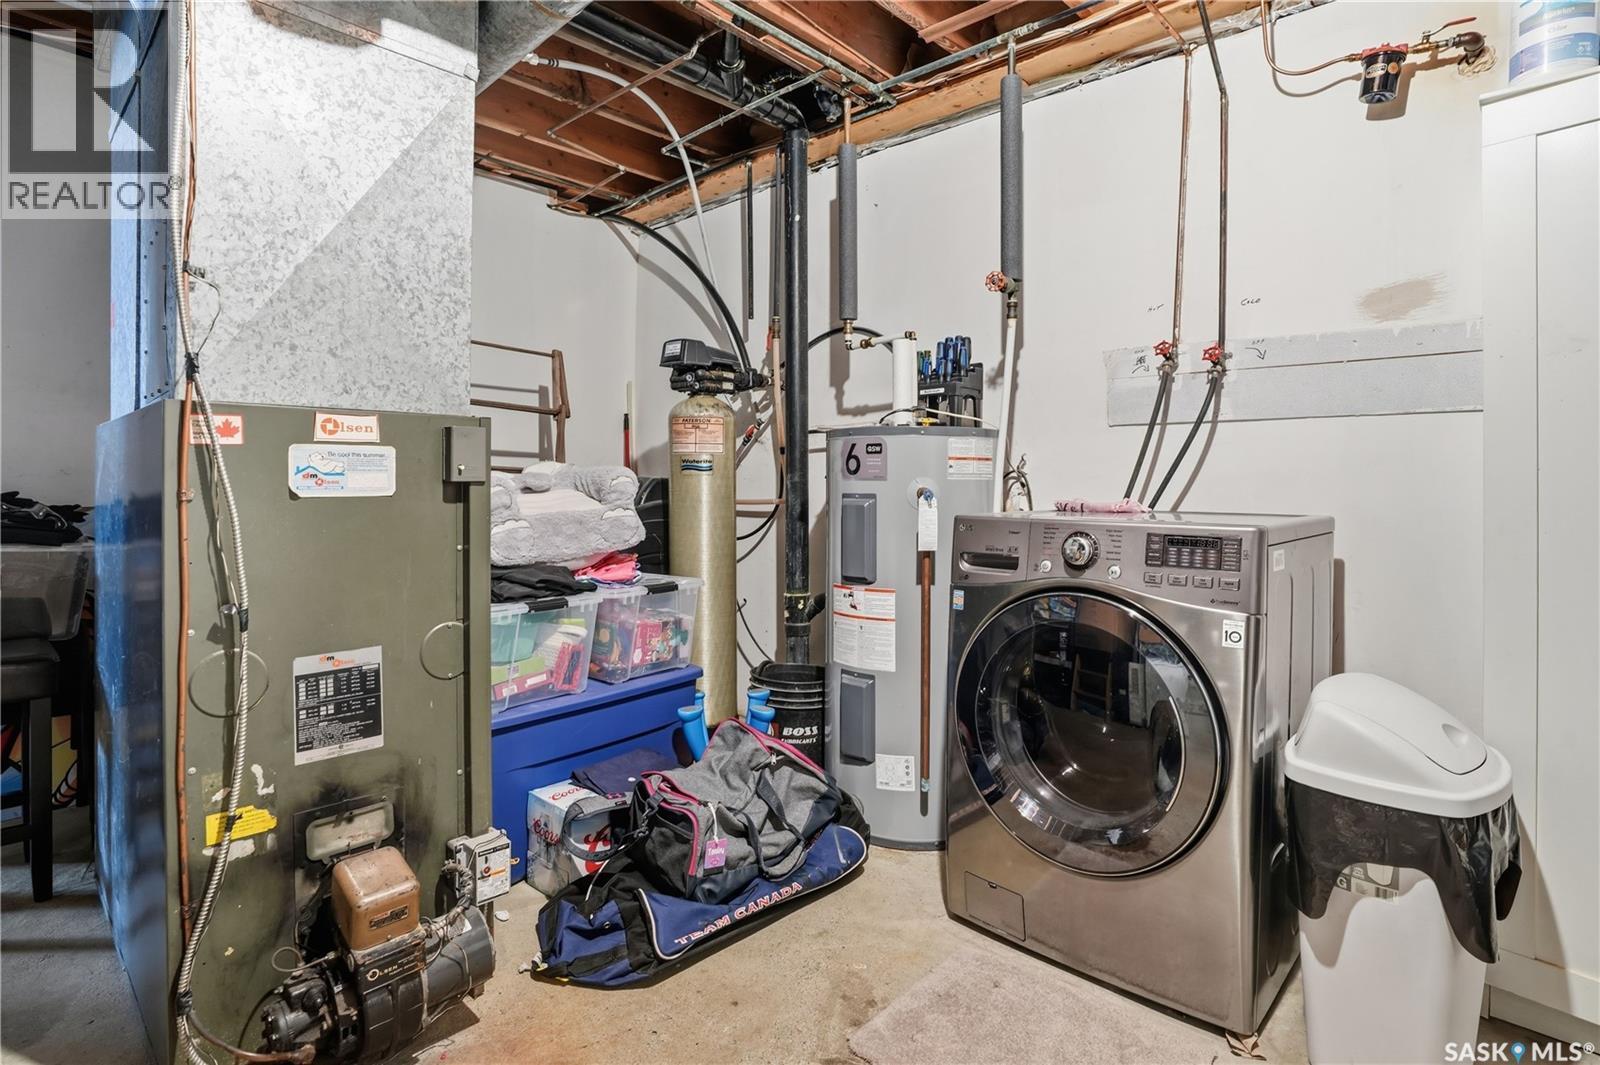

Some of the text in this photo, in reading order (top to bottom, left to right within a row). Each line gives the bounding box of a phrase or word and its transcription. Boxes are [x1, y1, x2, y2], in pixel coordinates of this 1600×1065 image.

[320, 417, 375, 436] Olsen
[845, 442, 861, 476] 6
[302, 471, 319, 480] dm
[1224, 629, 1243, 644] 10
[782, 725, 819, 737] BOSS
[674, 881, 803, 945] TEAM CANADA
